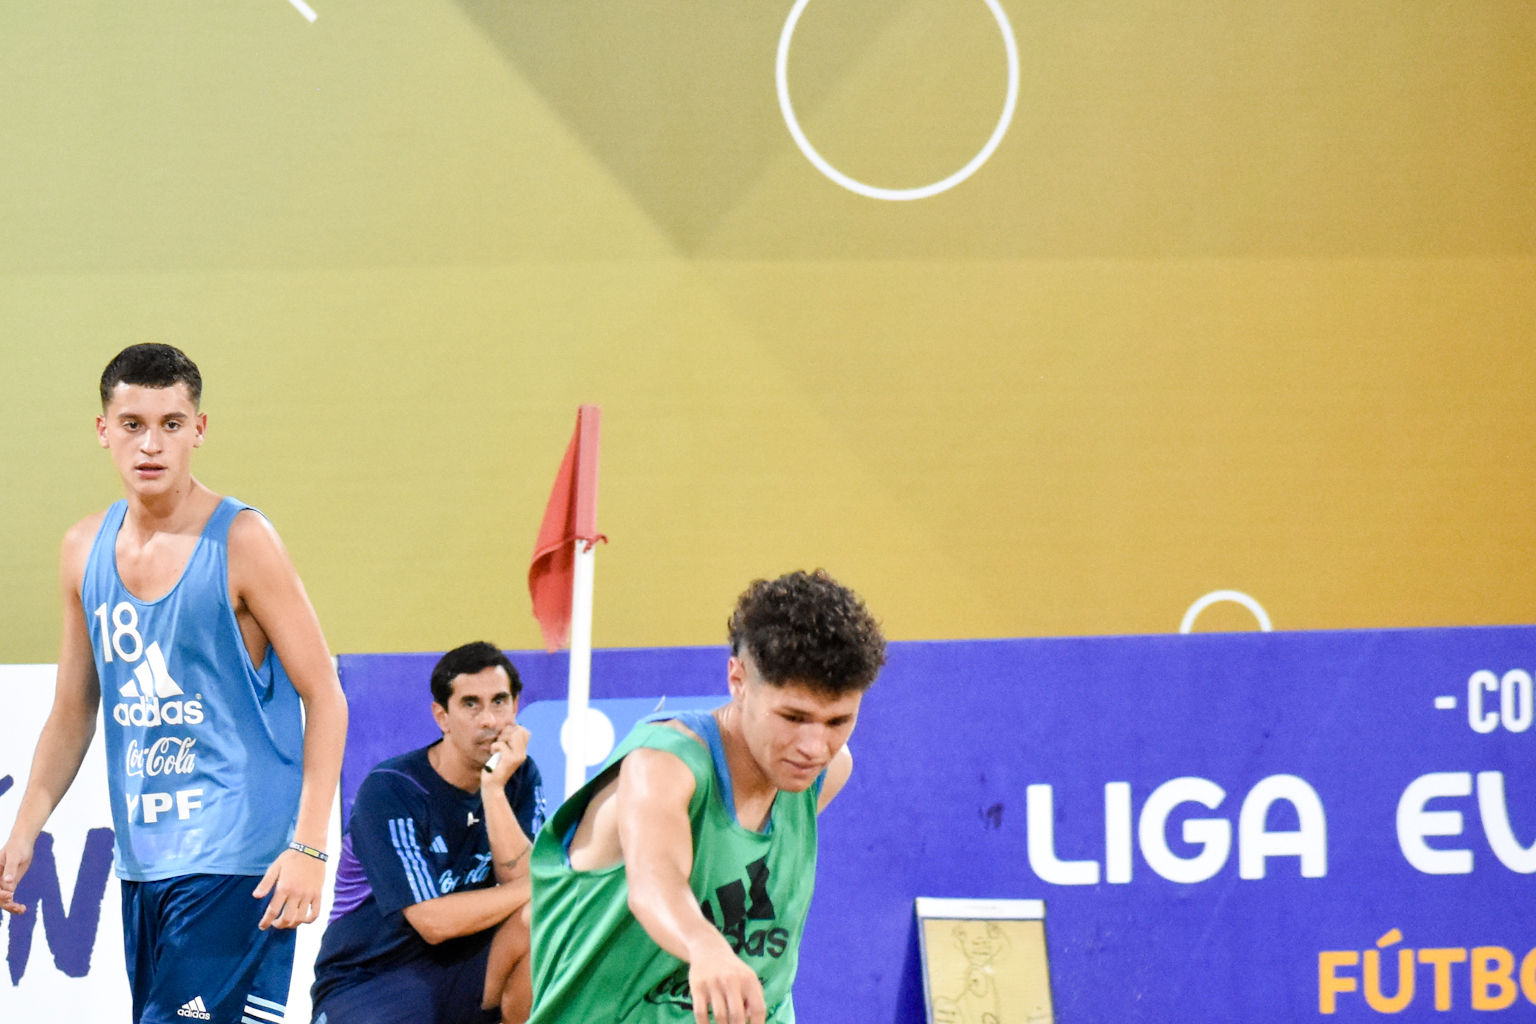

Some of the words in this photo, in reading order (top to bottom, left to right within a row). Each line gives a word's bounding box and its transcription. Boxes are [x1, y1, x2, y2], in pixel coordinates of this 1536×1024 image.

[94, 601, 143, 663] 18
[113, 695, 204, 727] addas
[1026, 774, 1328, 885] LIGA
[1396, 771, 1536, 875] EV
[1318, 928, 1536, 1015] FÚTB
[177, 1008, 211, 1020] adidas
